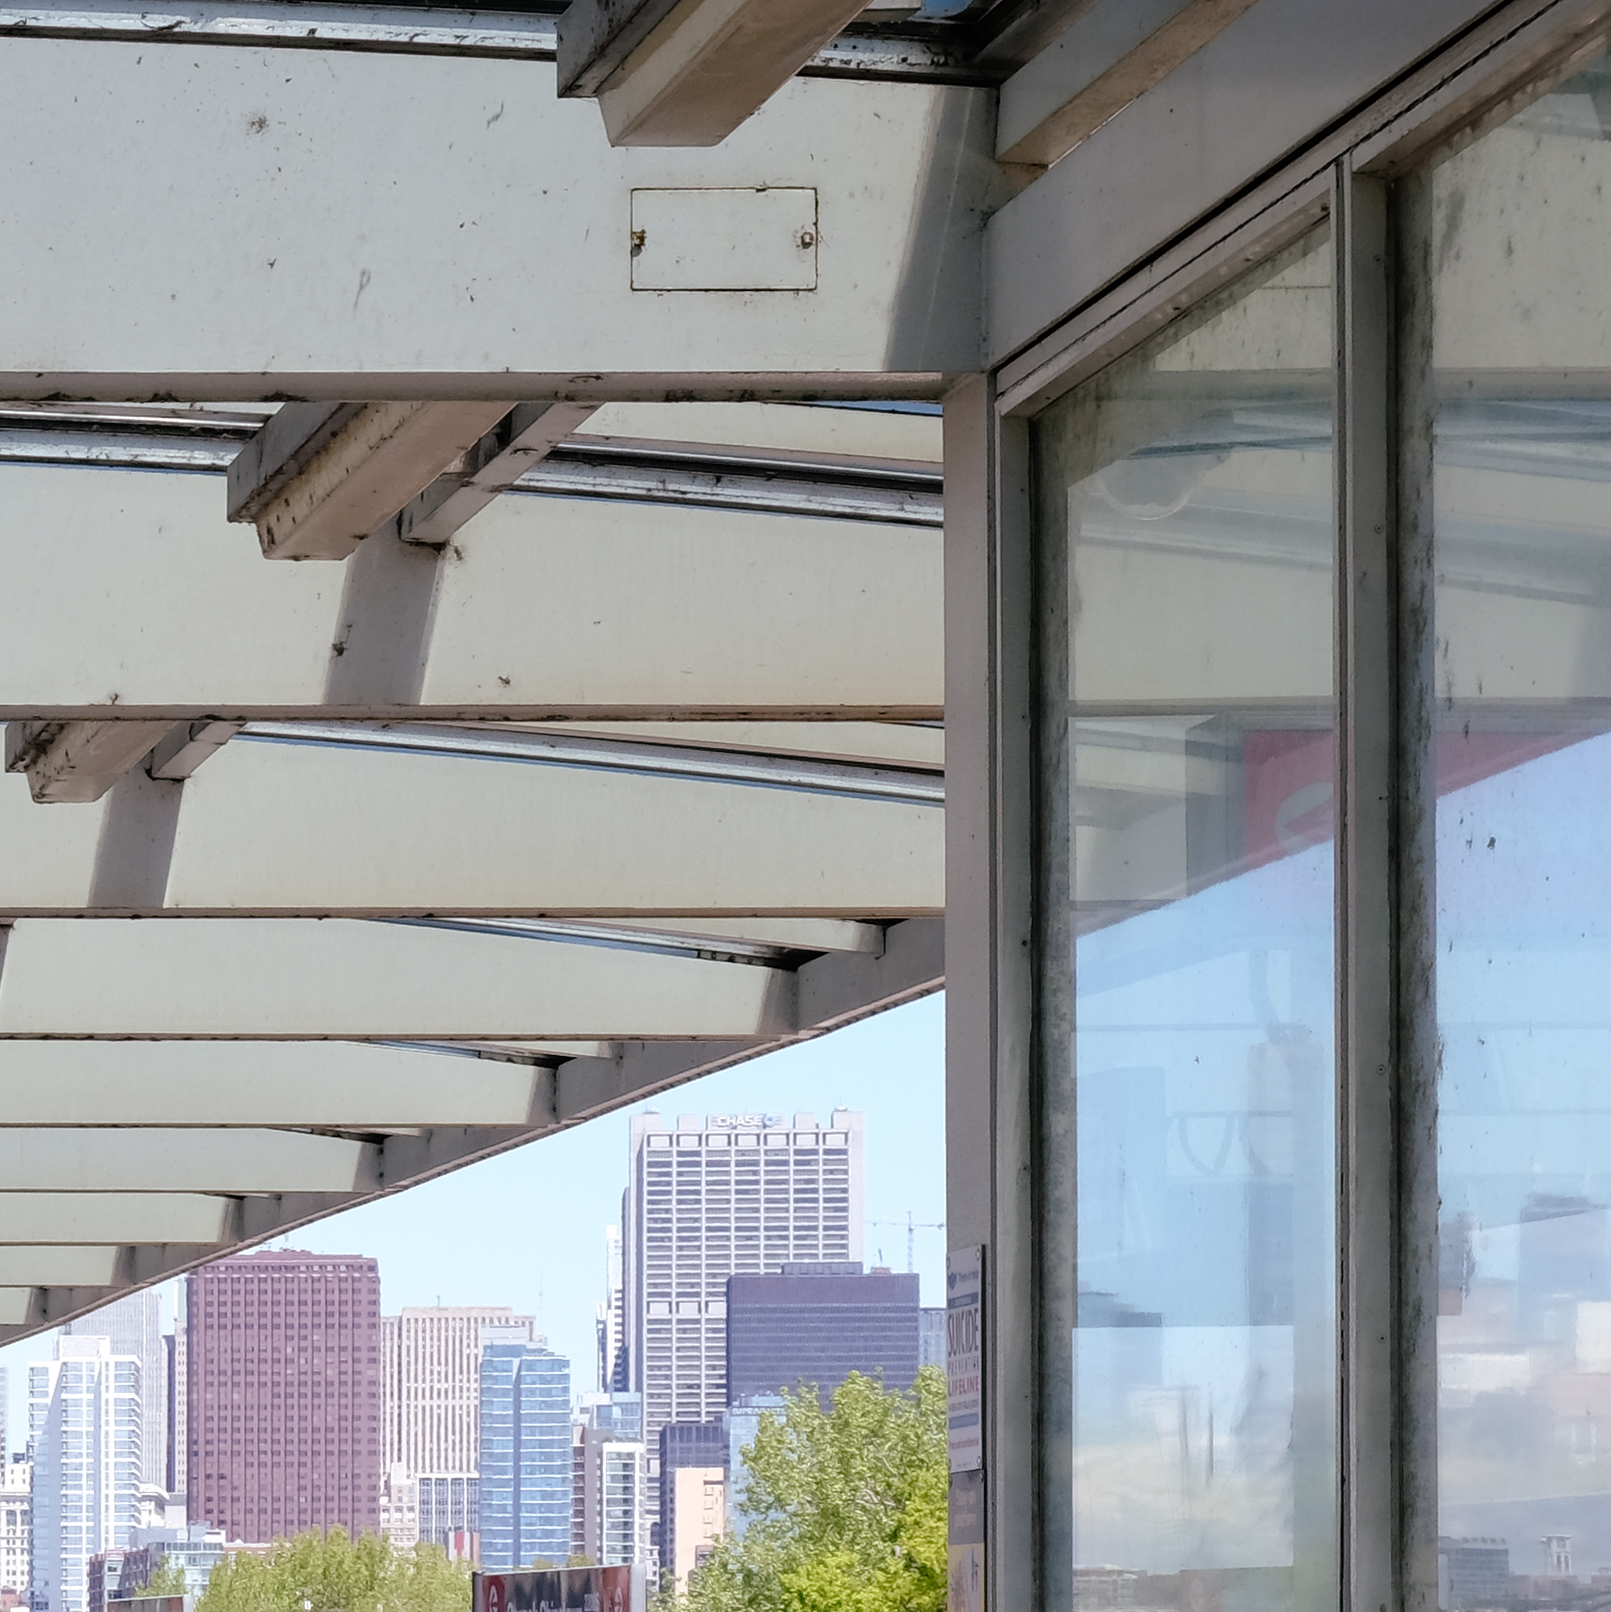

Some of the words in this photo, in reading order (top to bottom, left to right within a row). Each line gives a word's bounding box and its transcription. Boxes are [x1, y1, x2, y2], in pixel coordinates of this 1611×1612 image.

[717, 1115, 763, 1126] CHASE
[948, 1307, 979, 1357] SUICIDE
[948, 1376, 979, 1397] LIFELINE
